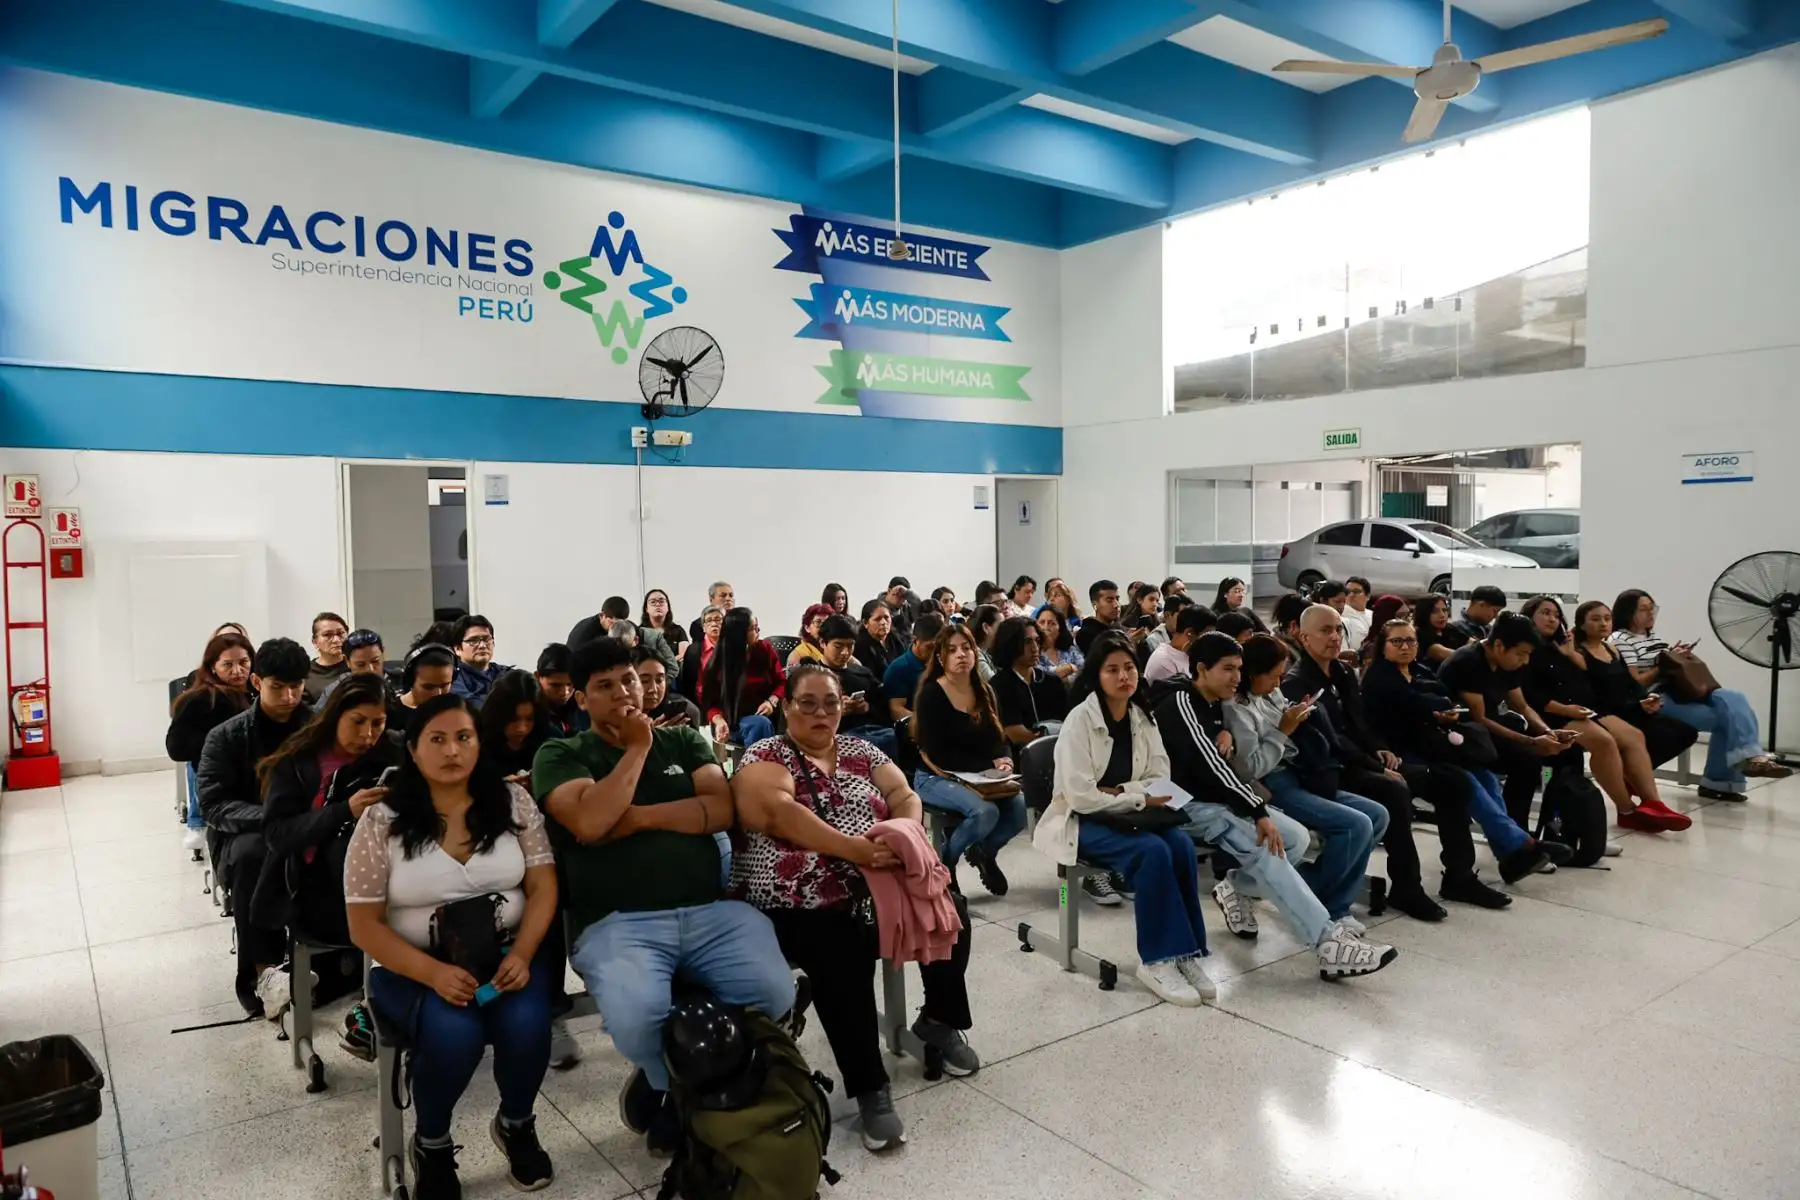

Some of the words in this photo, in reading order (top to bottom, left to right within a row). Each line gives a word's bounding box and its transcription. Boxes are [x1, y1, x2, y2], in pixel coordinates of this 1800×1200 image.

[59, 176, 534, 277] MIGRACIONES
[815, 222, 869, 255] MÁS
[874, 237, 968, 270] EFCIENTE
[271, 252, 452, 287] Superintendencia
[458, 274, 533, 296] Nacional
[459, 296, 533, 323] PERÚ
[834, 290, 888, 323] MÁS
[892, 303, 986, 331] MODERNA
[856, 354, 908, 387] MÁS
[912, 365, 995, 389] HUMANA
[1326, 433, 1357, 446] SALIDA
[1695, 456, 1739, 467] AFORO
[1320, 940, 1373, 965] AIR
